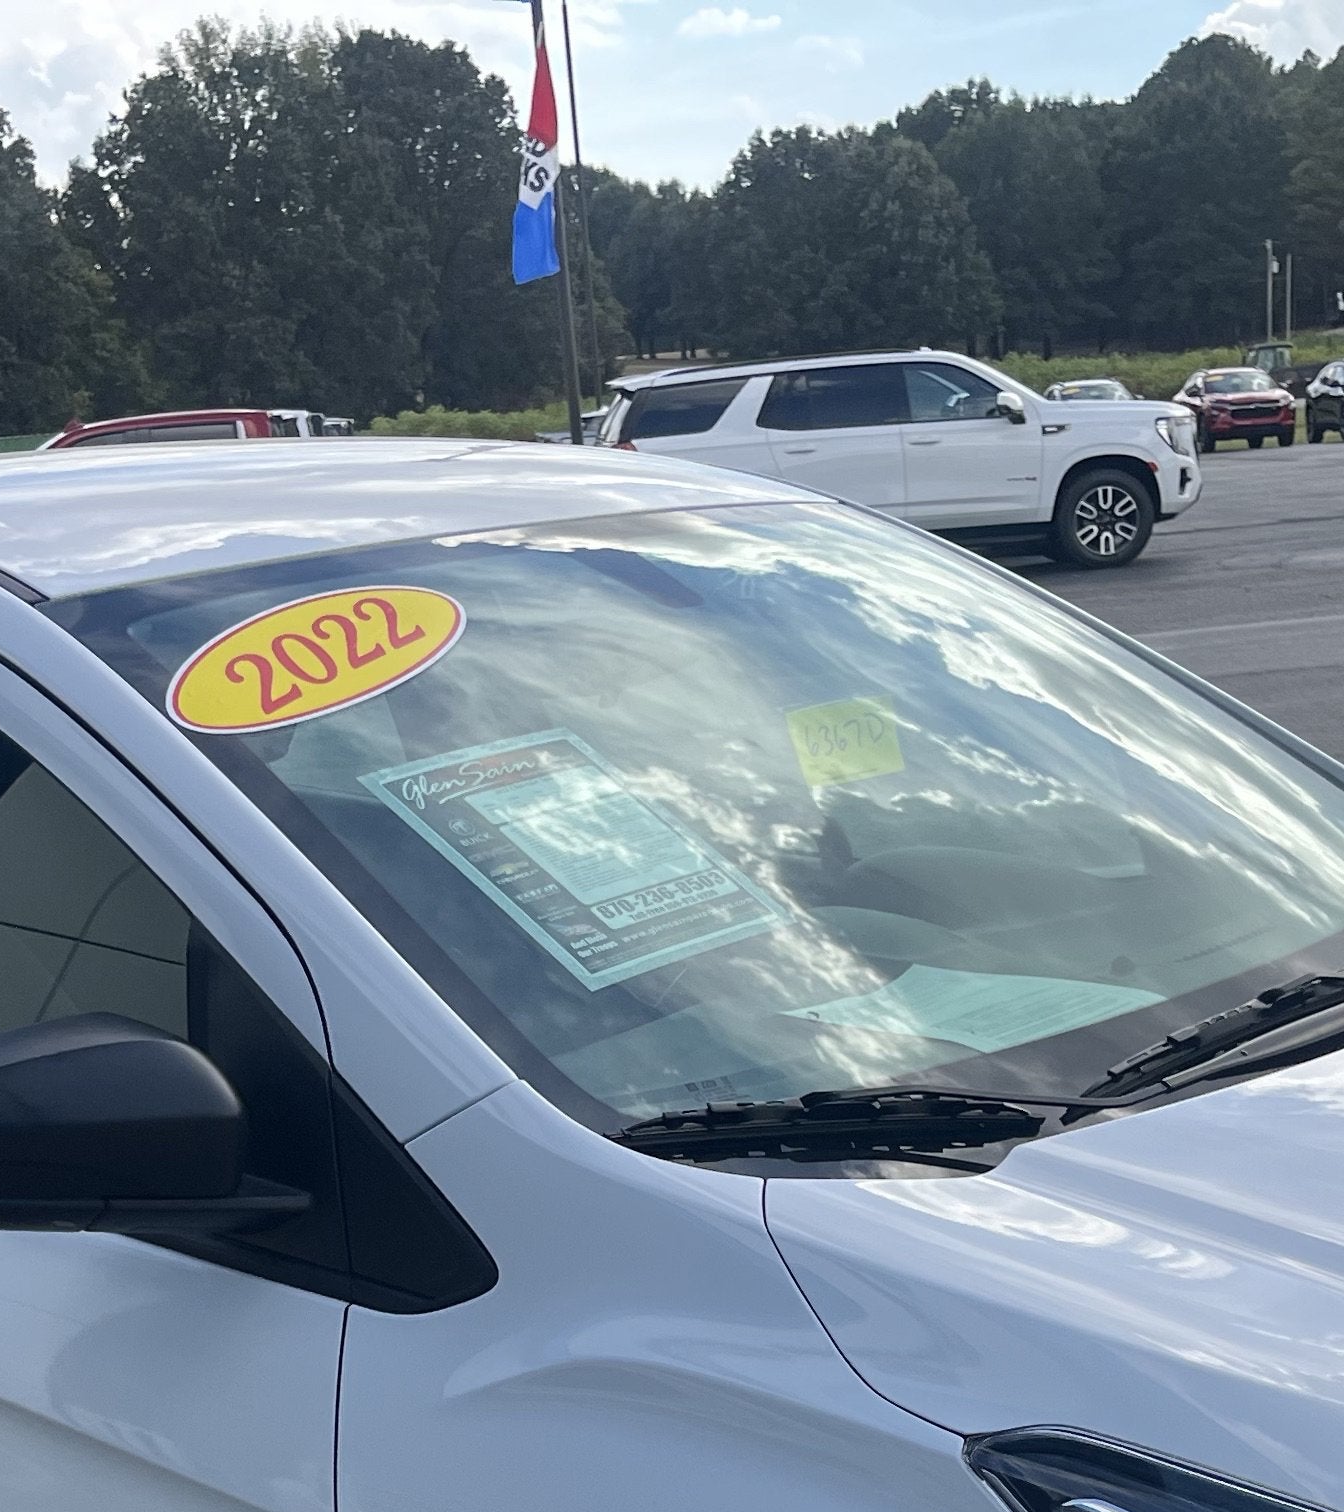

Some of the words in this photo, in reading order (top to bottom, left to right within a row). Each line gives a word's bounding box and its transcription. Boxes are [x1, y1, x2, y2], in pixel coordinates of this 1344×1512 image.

[224, 597, 426, 715] 2022
[402, 775, 465, 809] Glen
[459, 761, 535, 786] Sain
